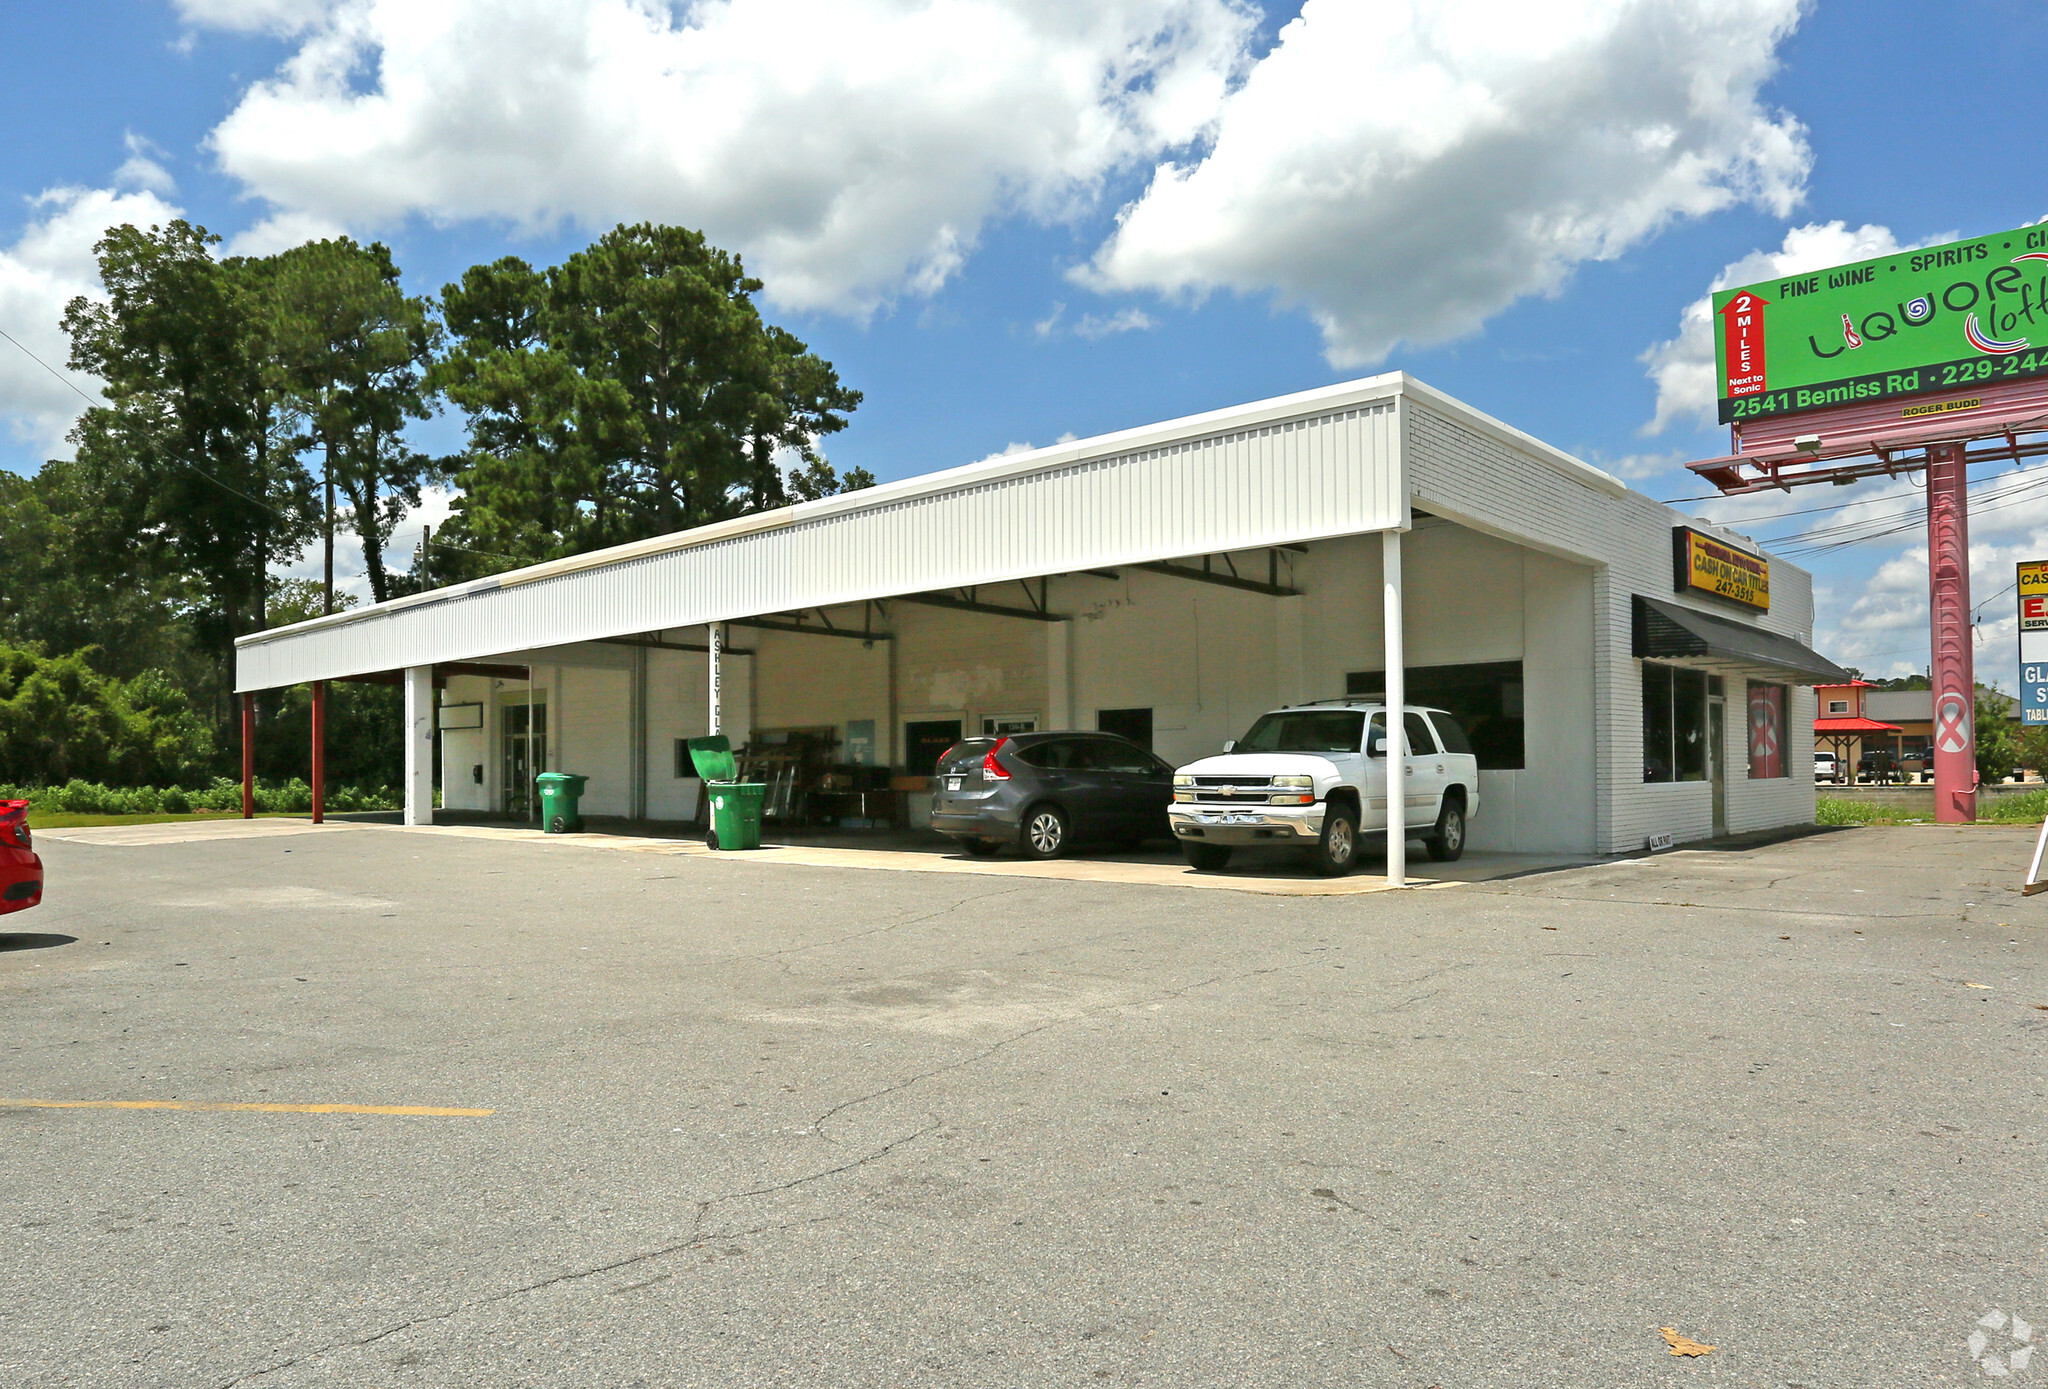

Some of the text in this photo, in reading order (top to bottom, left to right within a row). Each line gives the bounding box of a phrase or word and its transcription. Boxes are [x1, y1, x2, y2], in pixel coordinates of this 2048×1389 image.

[1780, 230, 2048, 300] FINE WINE SPIRITS CI
[1736, 296, 1751, 372] 2 MILES
[1729, 374, 1764, 386] Next to
[1733, 384, 1761, 394] Sonic
[1733, 393, 1790, 418] 2541
[1796, 380, 1882, 408] Bemiss
[1887, 371, 1919, 393] Rd
[1903, 399, 1979, 416] ROGER BUDD
[1694, 554, 1719, 577] CASH
[1720, 563, 1732, 581] ON
[1733, 568, 1748, 587] CAR
[1748, 574, 1769, 594] TITLES
[1715, 579, 1755, 602] 247-3515
[2024, 666, 2048, 683] GL
[2036, 687, 2048, 703] S
[2025, 709, 2048, 721] TABL
